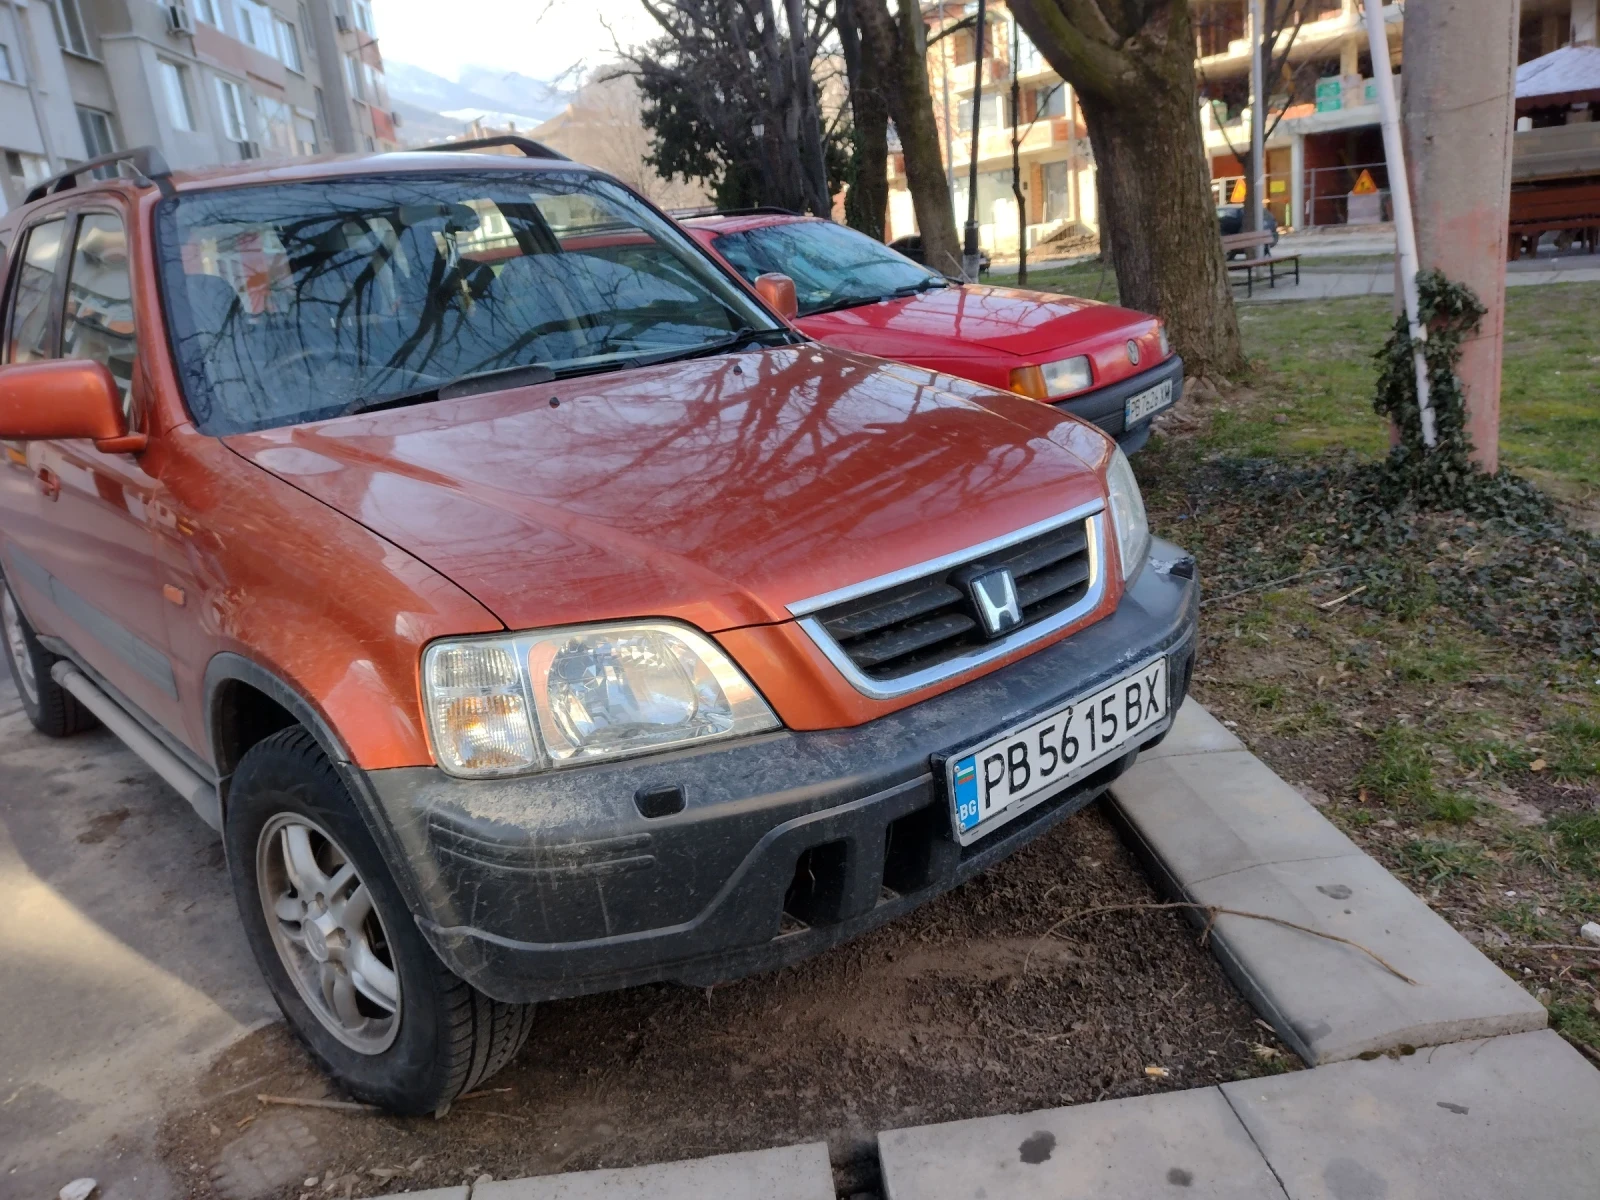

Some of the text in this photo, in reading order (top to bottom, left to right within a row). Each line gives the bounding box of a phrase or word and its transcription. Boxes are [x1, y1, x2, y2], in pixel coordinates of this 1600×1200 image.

[983, 669, 1160, 810] PB 5615 BX
[959, 799, 977, 820] BG
